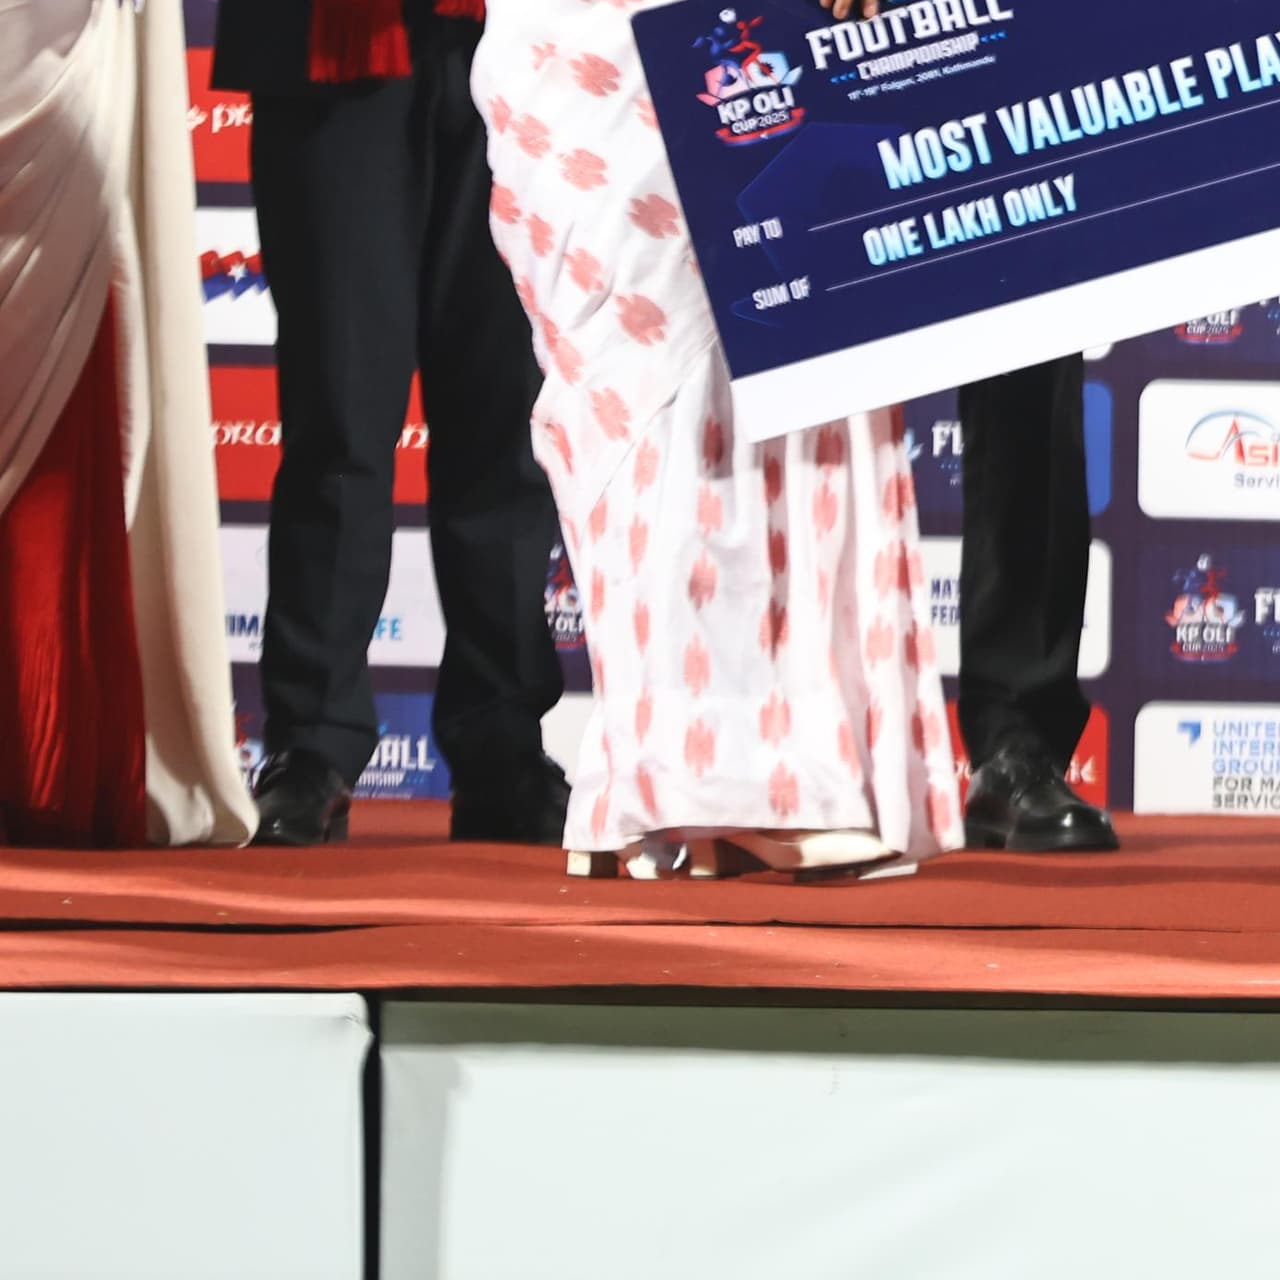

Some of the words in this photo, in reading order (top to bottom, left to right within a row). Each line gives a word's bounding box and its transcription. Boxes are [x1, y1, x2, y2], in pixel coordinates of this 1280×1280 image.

[857, 31, 980, 81] CHAMPIONSHIP
[942, 54, 998, 77] Kathmandu
[716, 98, 750, 125] KP
[752, 86, 796, 115] OLI
[731, 121, 758, 135] CUP
[756, 110, 790, 130] 2025
[876, 113, 993, 191] MOST
[996, 56, 1204, 156] VALUABLE
[732, 222, 761, 249] PAY
[760, 216, 784, 240] TO
[862, 217, 925, 267] ONE
[923, 195, 1003, 250] LAKH
[1003, 173, 1078, 228] ONLY
[752, 282, 790, 311] SUM
[789, 275, 811, 301] OF
[1212, 776, 1252, 792] FOR
